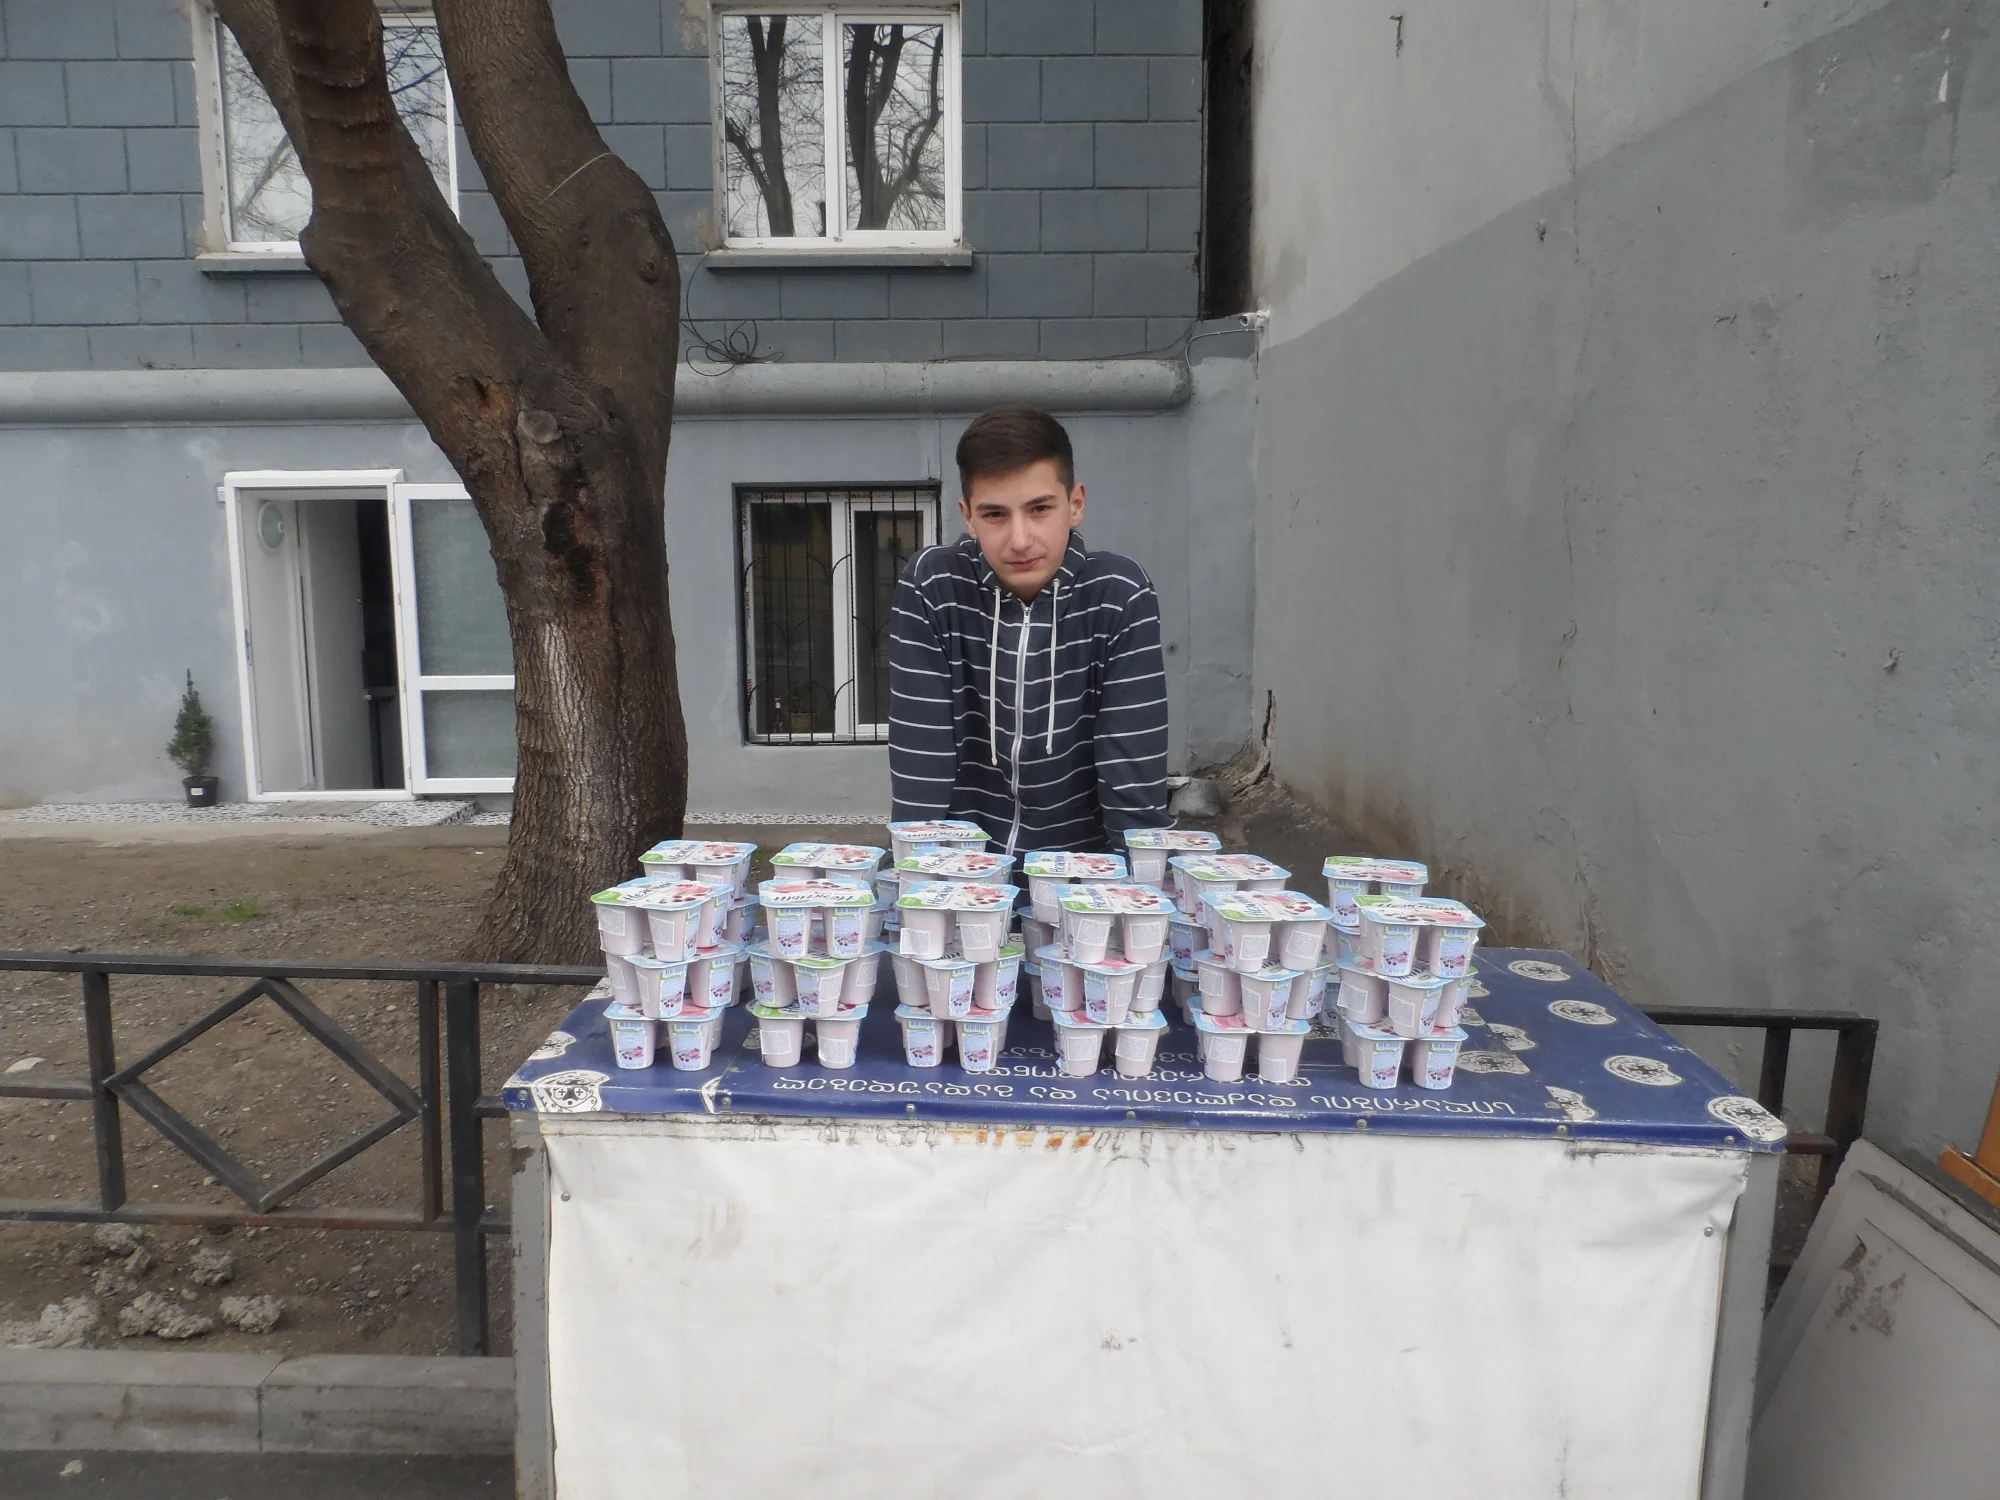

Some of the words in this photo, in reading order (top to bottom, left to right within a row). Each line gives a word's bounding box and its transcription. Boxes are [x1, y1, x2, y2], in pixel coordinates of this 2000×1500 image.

[772, 1076, 1014, 1098] გადაუდებელ
[1029, 1085, 1077, 1101] და
[1092, 1087, 1297, 1108] დაძლევისა
[1310, 1094, 1516, 1115] სიღარიბის
